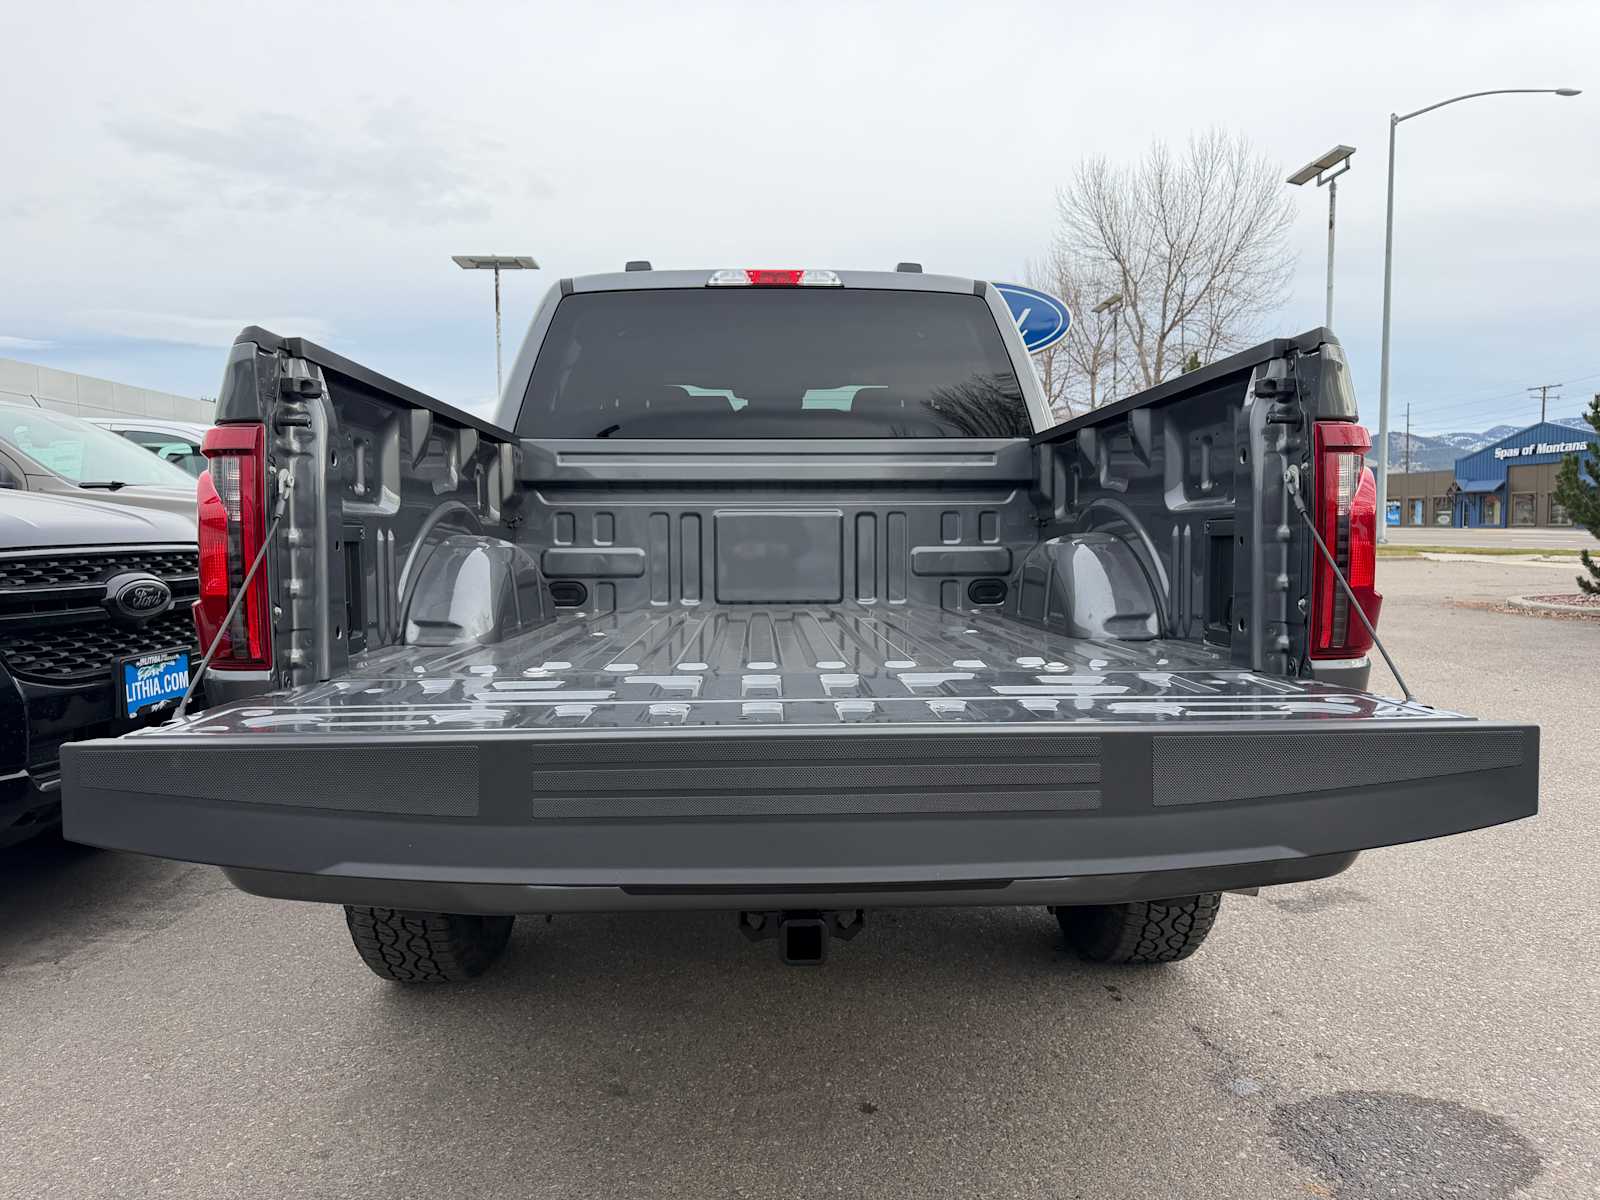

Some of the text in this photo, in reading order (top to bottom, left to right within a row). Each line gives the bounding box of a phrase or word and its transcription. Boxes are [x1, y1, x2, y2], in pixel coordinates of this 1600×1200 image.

[1494, 441, 1588, 460] Spas of Montana
[133, 587, 162, 608] Ford
[125, 670, 189, 703] LITHIA.COM
